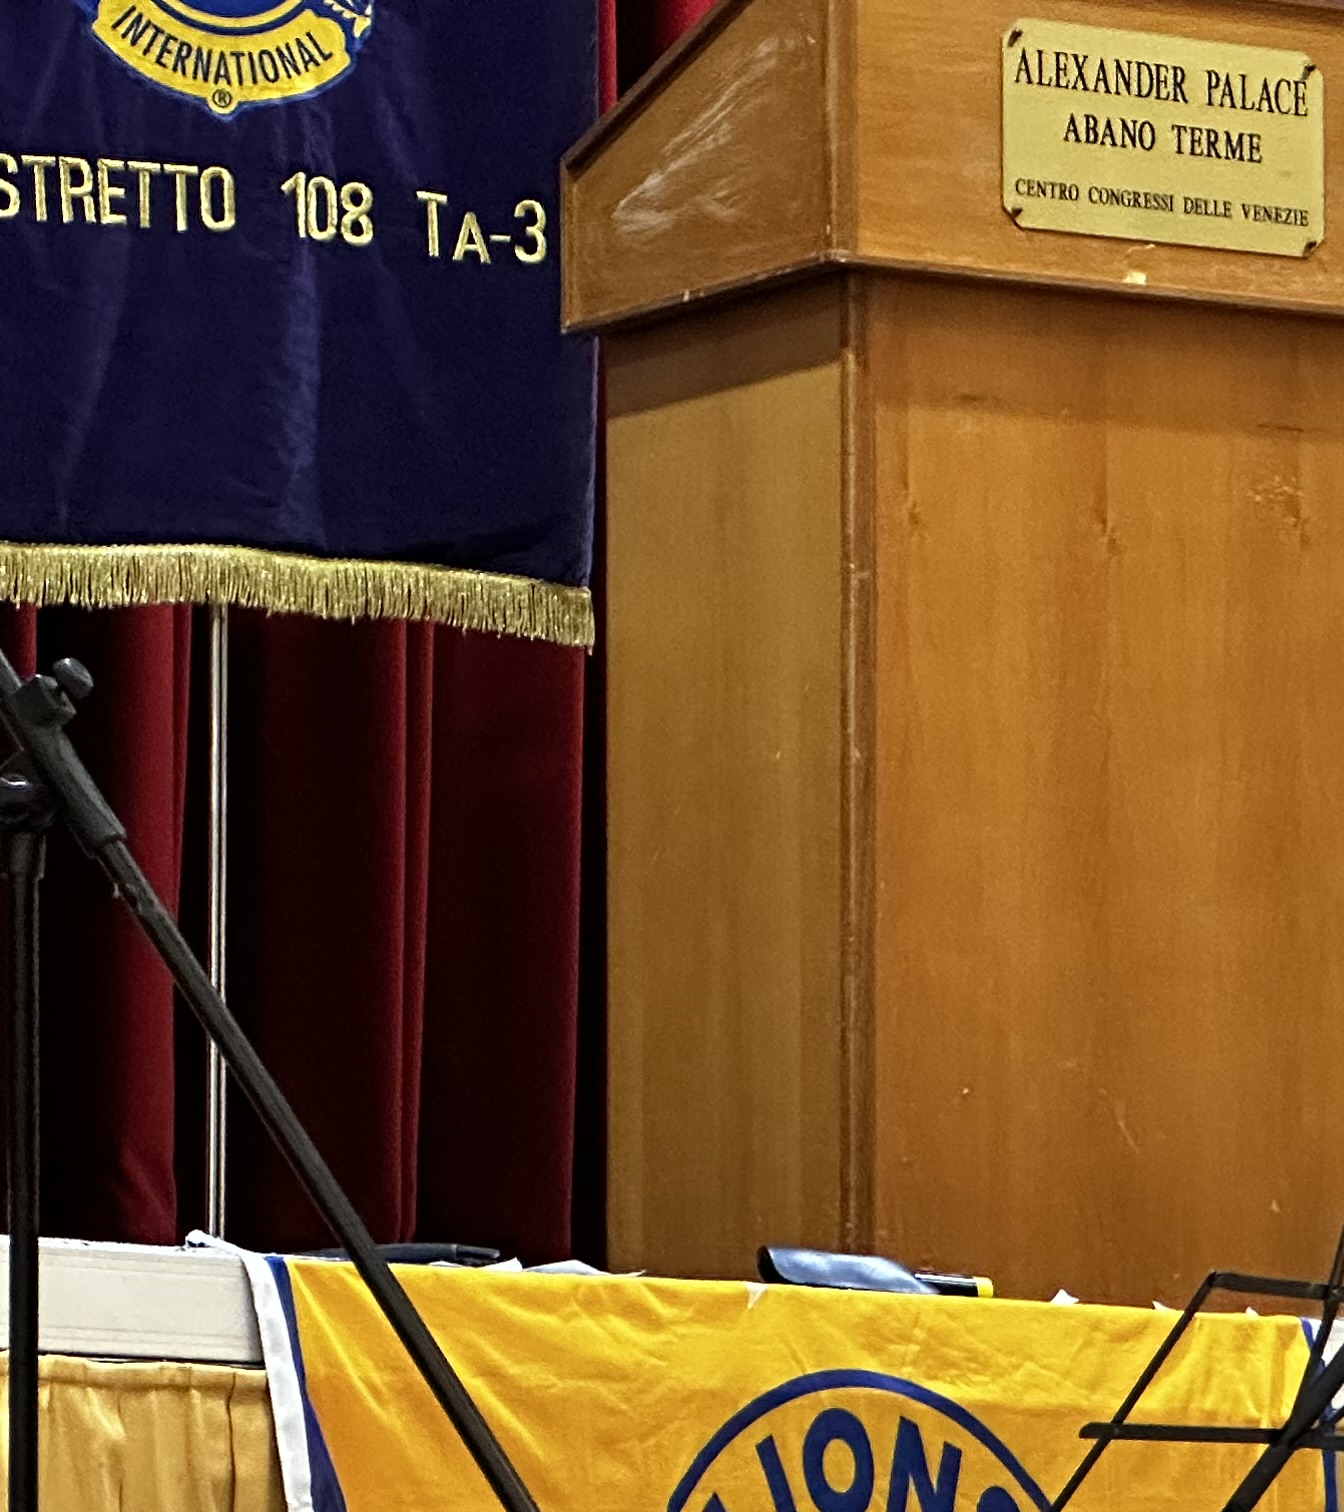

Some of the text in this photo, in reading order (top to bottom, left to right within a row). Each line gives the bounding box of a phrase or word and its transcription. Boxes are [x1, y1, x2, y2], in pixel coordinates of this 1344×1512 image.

[111, 4, 334, 87] INTERNATIONAL
[1014, 48, 1309, 117] ALEXANDER PALACE
[1063, 113, 1263, 164] ABANO TERME
[280, 171, 375, 245] 108
[1014, 178, 1309, 227] CENTRO CONGRESSI DELLE VENEZIE
